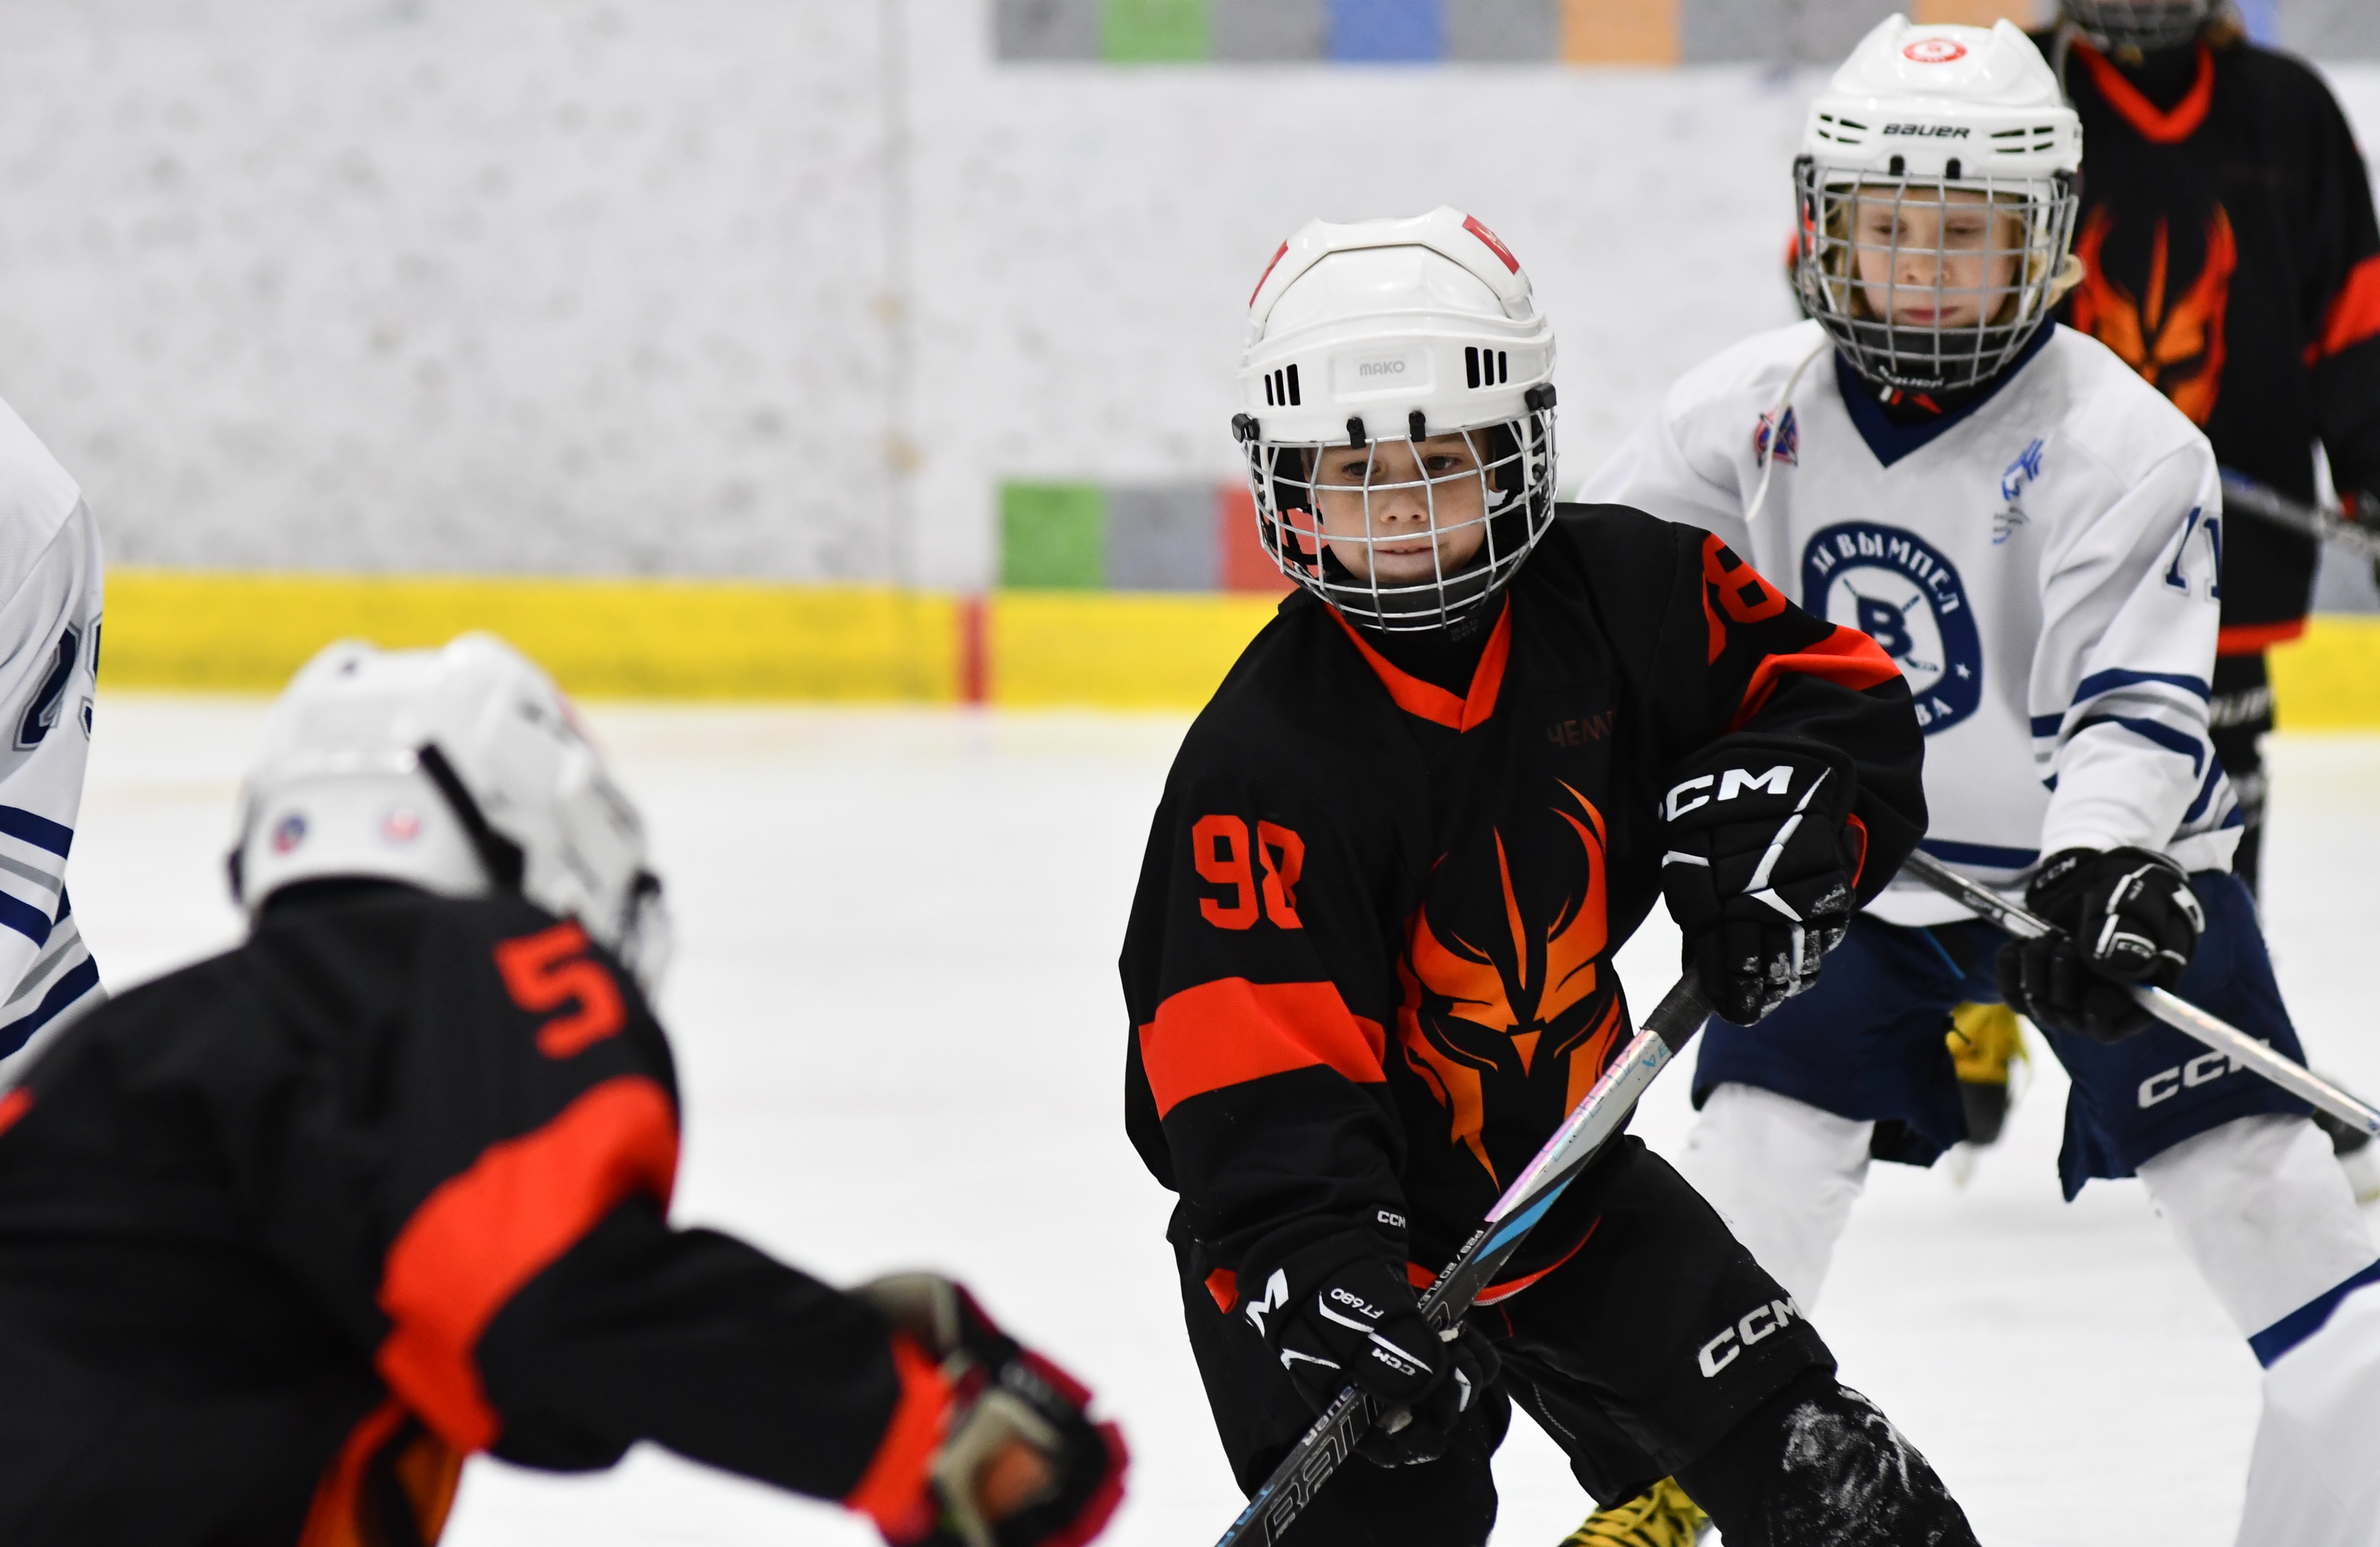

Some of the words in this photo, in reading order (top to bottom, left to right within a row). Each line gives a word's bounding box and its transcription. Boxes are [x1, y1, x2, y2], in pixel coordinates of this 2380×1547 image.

[1883, 123, 1970, 138] BAUER
[1360, 361, 1405, 376] MAKO
[1658, 765, 1794, 822] CM
[1192, 814, 1305, 931] 98
[493, 919, 627, 1060] 5
[1377, 1210, 1406, 1229] CCM
[1330, 1288, 1385, 1319] FT680
[1417, 1280, 1443, 1310] FLEX
[1698, 1297, 1805, 1378] CCM
[1371, 1347, 1416, 1376] CCM
[1301, 1382, 1358, 1446] AUER
